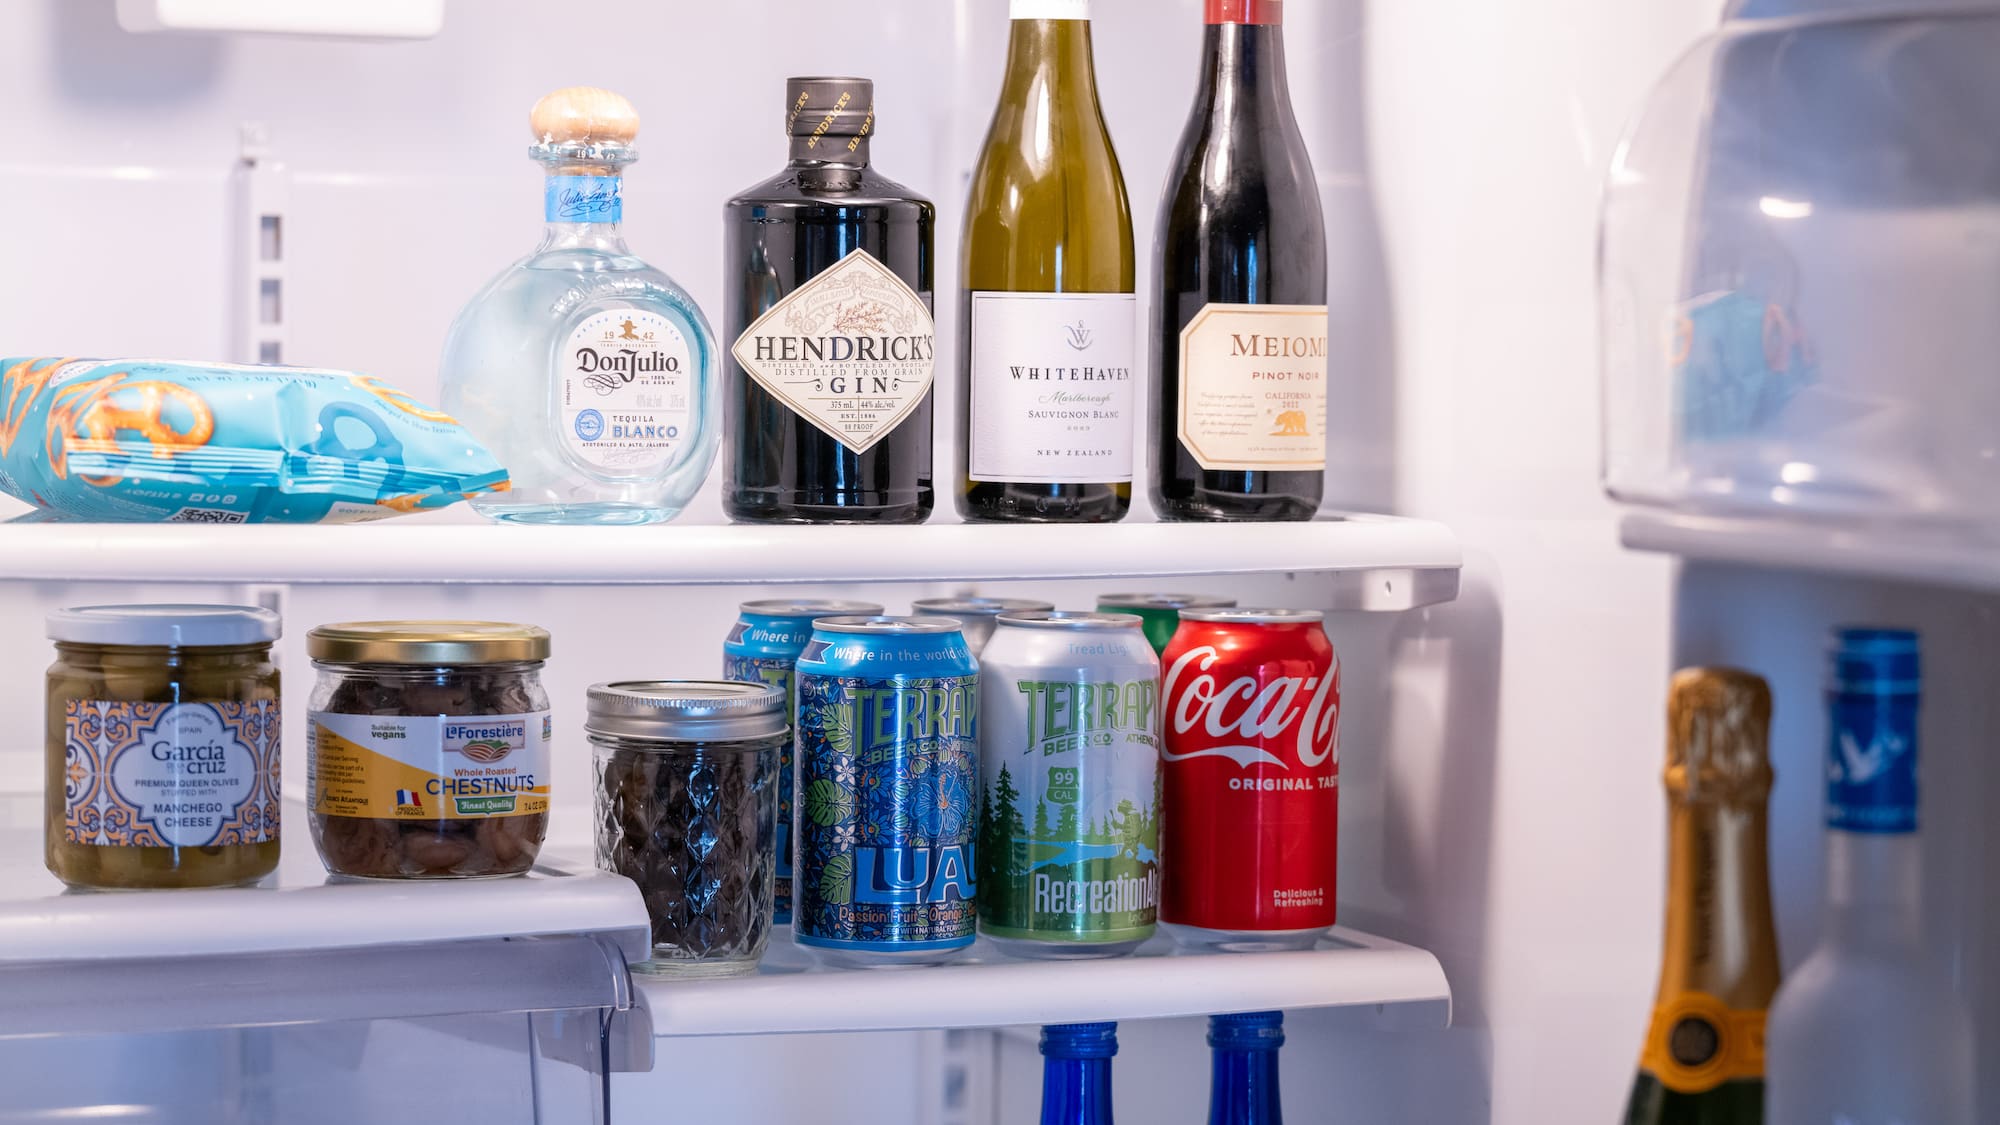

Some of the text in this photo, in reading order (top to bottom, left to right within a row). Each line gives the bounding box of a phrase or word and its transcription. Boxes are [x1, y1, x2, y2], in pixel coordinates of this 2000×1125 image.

[604, 331, 655, 340] 19 42
[754, 335, 934, 362] HENDRICK'S
[775, 368, 924, 376] DISTILLED FROM GRAIN
[1252, 371, 1294, 381] PINOT
[829, 376, 888, 394] GIN
[1265, 391, 1312, 400] CALIFORNIA
[830, 401, 842, 409] 375
[612, 415, 655, 423] TEQUILA
[1028, 410, 1120, 419] SAUVIGNON BLANC
[612, 425, 679, 438] BLANCO
[751, 629, 806, 644] Where in
[833, 647, 875, 662] Where
[880, 647, 893, 661] in
[898, 647, 921, 662] the
[926, 647, 956, 661] world
[370, 731, 407, 740] vegans
[150, 739, 226, 762] García
[1043, 734, 1089, 757] BEER
[870, 743, 918, 765] BEER
[186, 760, 227, 775] cruz
[454, 766, 517, 777] Whole Roasted
[134, 778, 240, 787] PREMIUM QUEEN OLIVES
[1054, 771, 1075, 785] 99
[425, 774, 535, 796] CHESTNUTS
[1228, 778, 1314, 791] ORIGINAL
[160, 789, 197, 797] STUFFED
[1053, 790, 1073, 800] CAL
[153, 802, 224, 814] MANCHEGO
[461, 800, 513, 811] Finest Quality
[164, 816, 213, 828] CHEESE
[1273, 888, 1317, 898] Delicious
[1274, 897, 1324, 908] Refreshing
[838, 906, 888, 923] Passion
[889, 908, 918, 923] Fruit
[928, 907, 964, 923] Orange
